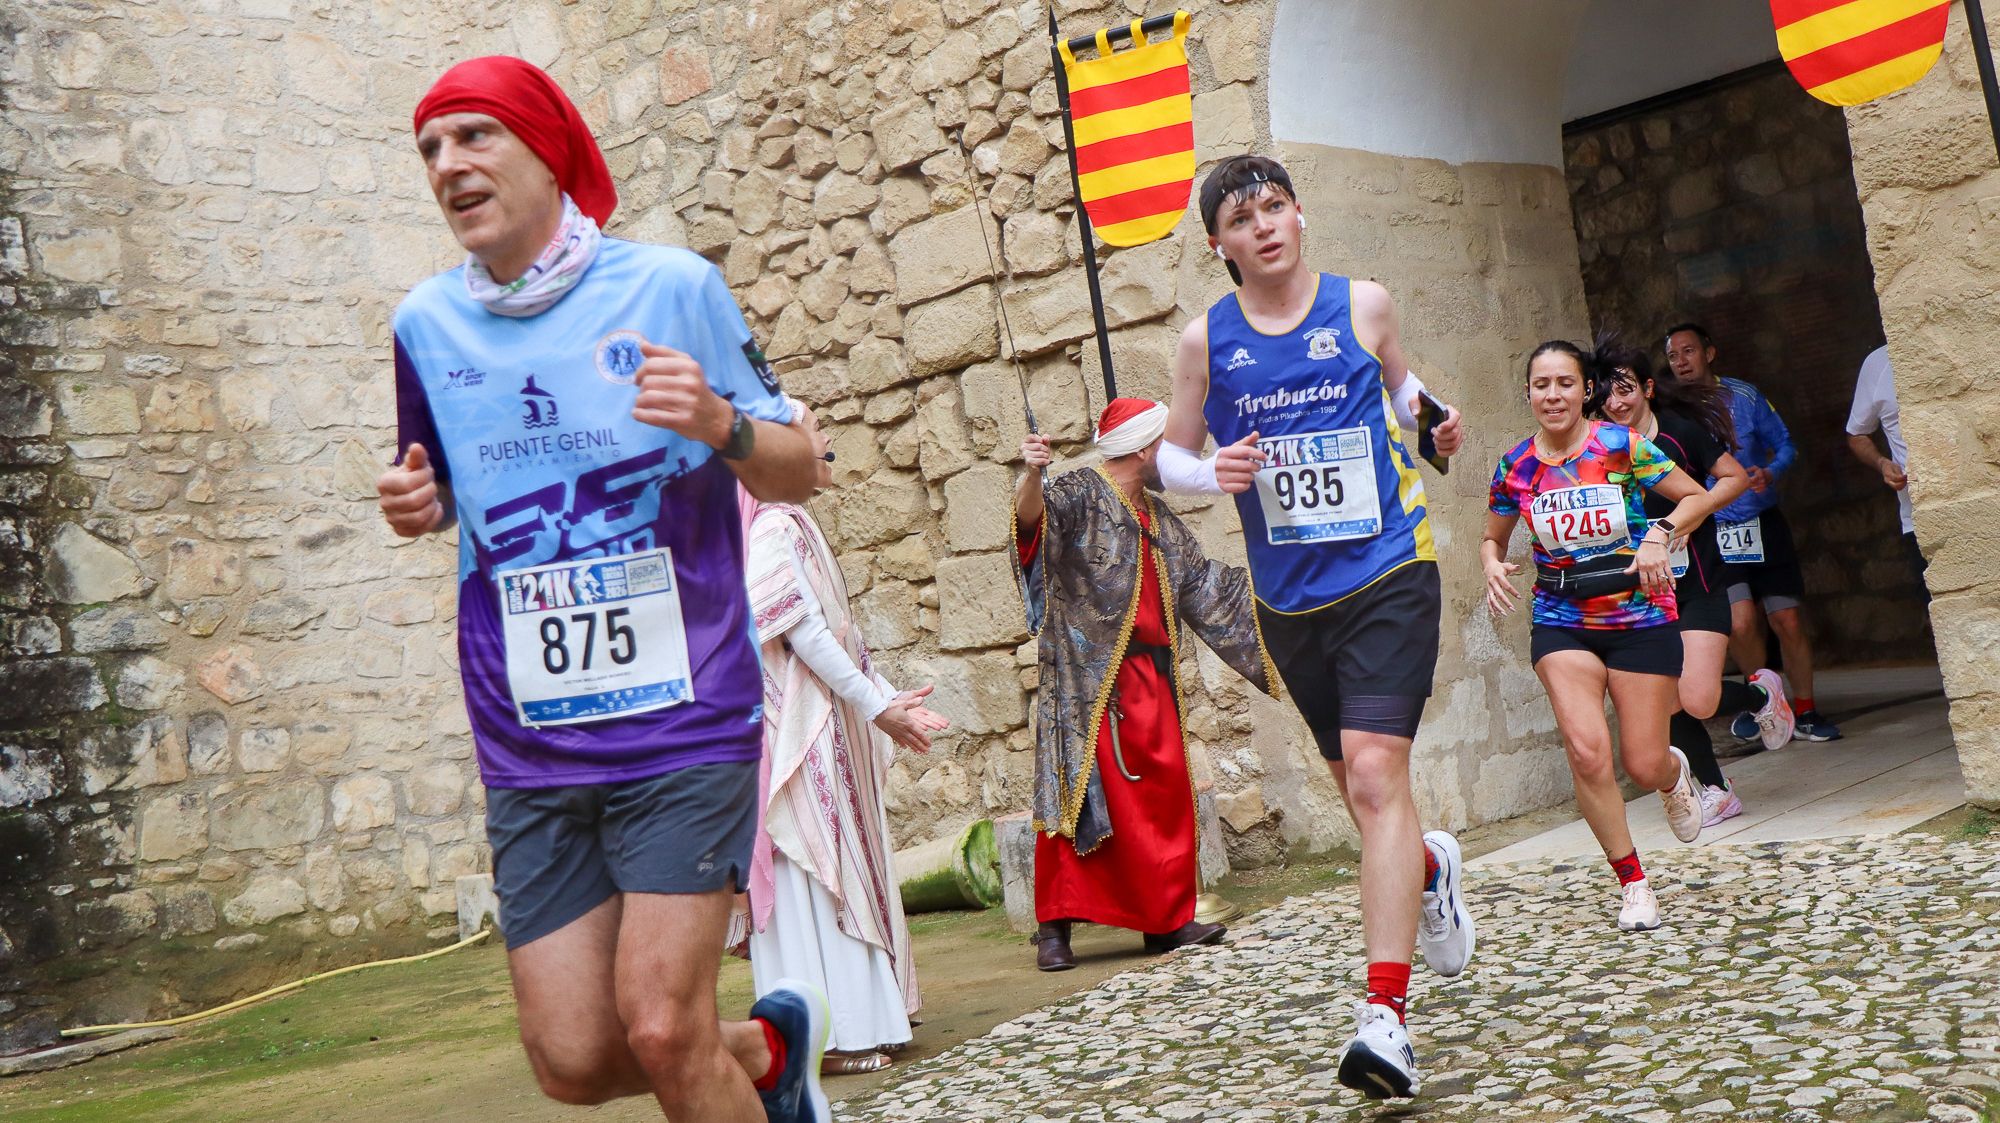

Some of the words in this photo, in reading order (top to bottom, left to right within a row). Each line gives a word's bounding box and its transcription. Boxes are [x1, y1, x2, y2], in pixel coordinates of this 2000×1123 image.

[1235, 379, 1348, 417] Tirabuzón
[479, 436, 553, 462] PUENTE
[557, 428, 620, 451] GENIL
[482, 449, 621, 474] AYUNTAMIENTO
[1264, 439, 1301, 467] 21K
[1274, 466, 1344, 511] 935
[1542, 491, 1572, 512] 21K
[1545, 509, 1612, 543] 1245
[1720, 528, 1754, 550] 214
[522, 569, 576, 611] 21K
[540, 607, 637, 675] 875
